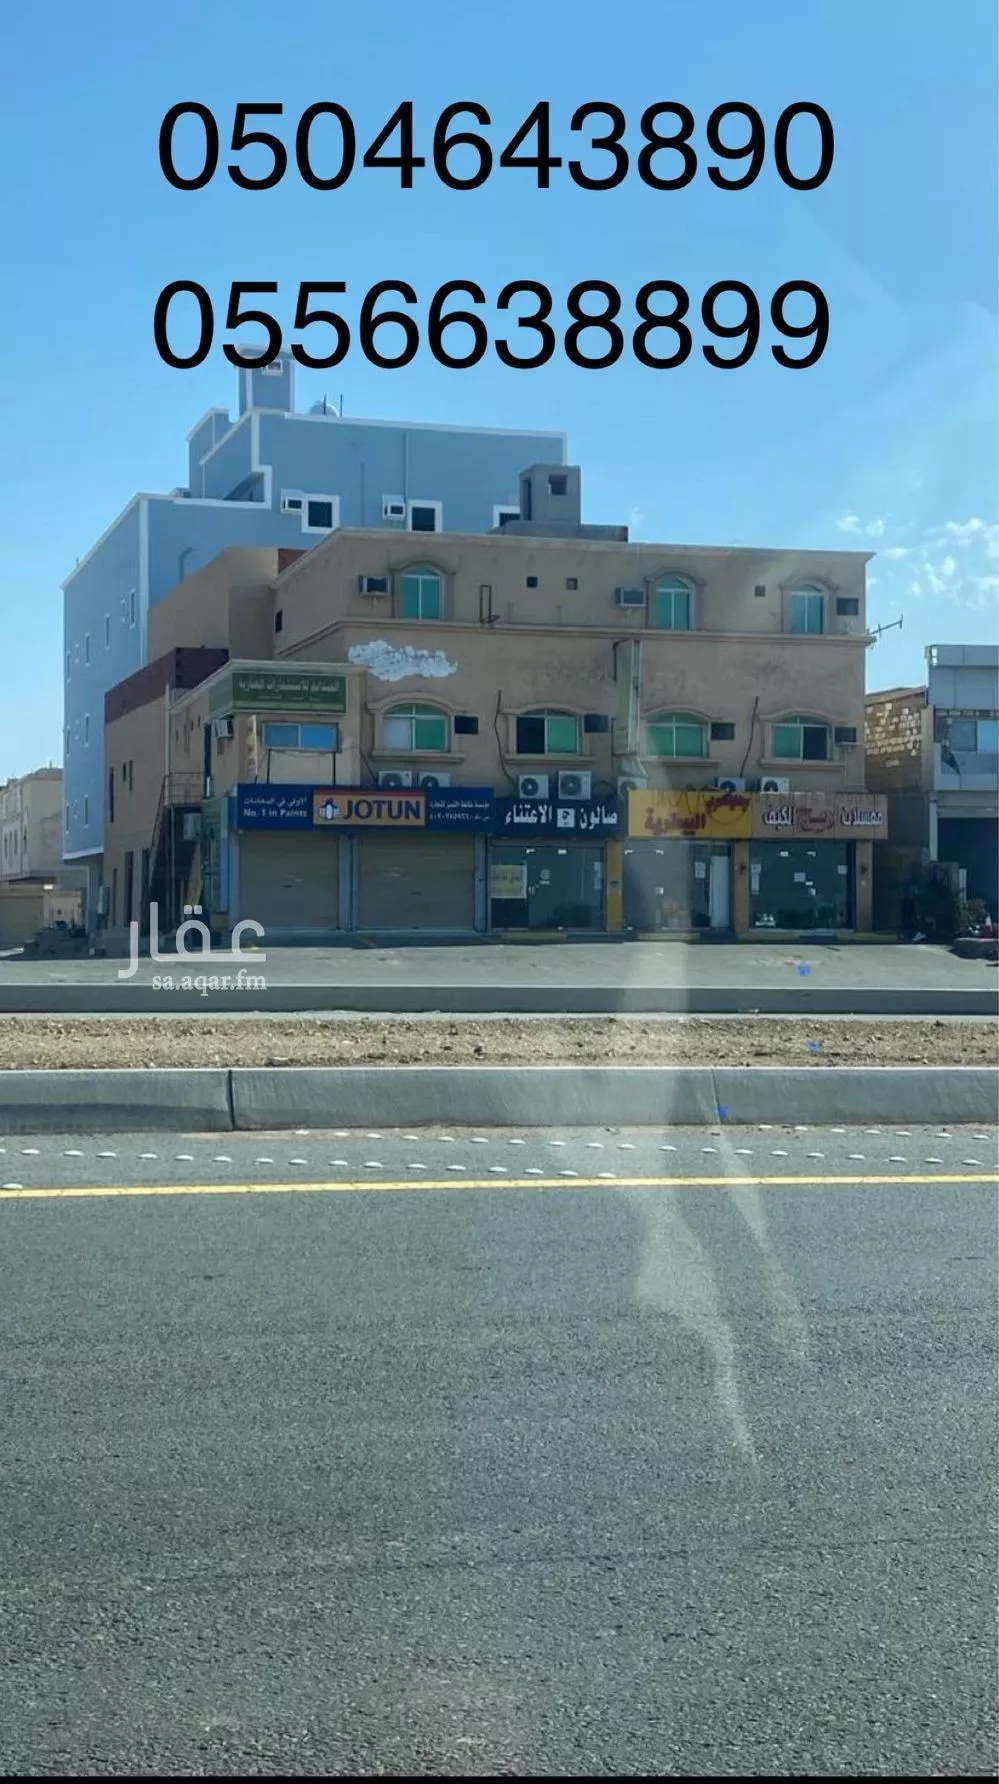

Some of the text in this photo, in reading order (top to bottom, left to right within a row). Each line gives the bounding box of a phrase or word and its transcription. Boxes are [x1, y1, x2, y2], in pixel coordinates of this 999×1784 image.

[268, 808, 278, 817] in
[280, 808, 308, 818] Paints
[343, 800, 420, 820] JOTUN
[580, 805, 618, 830] صالون
